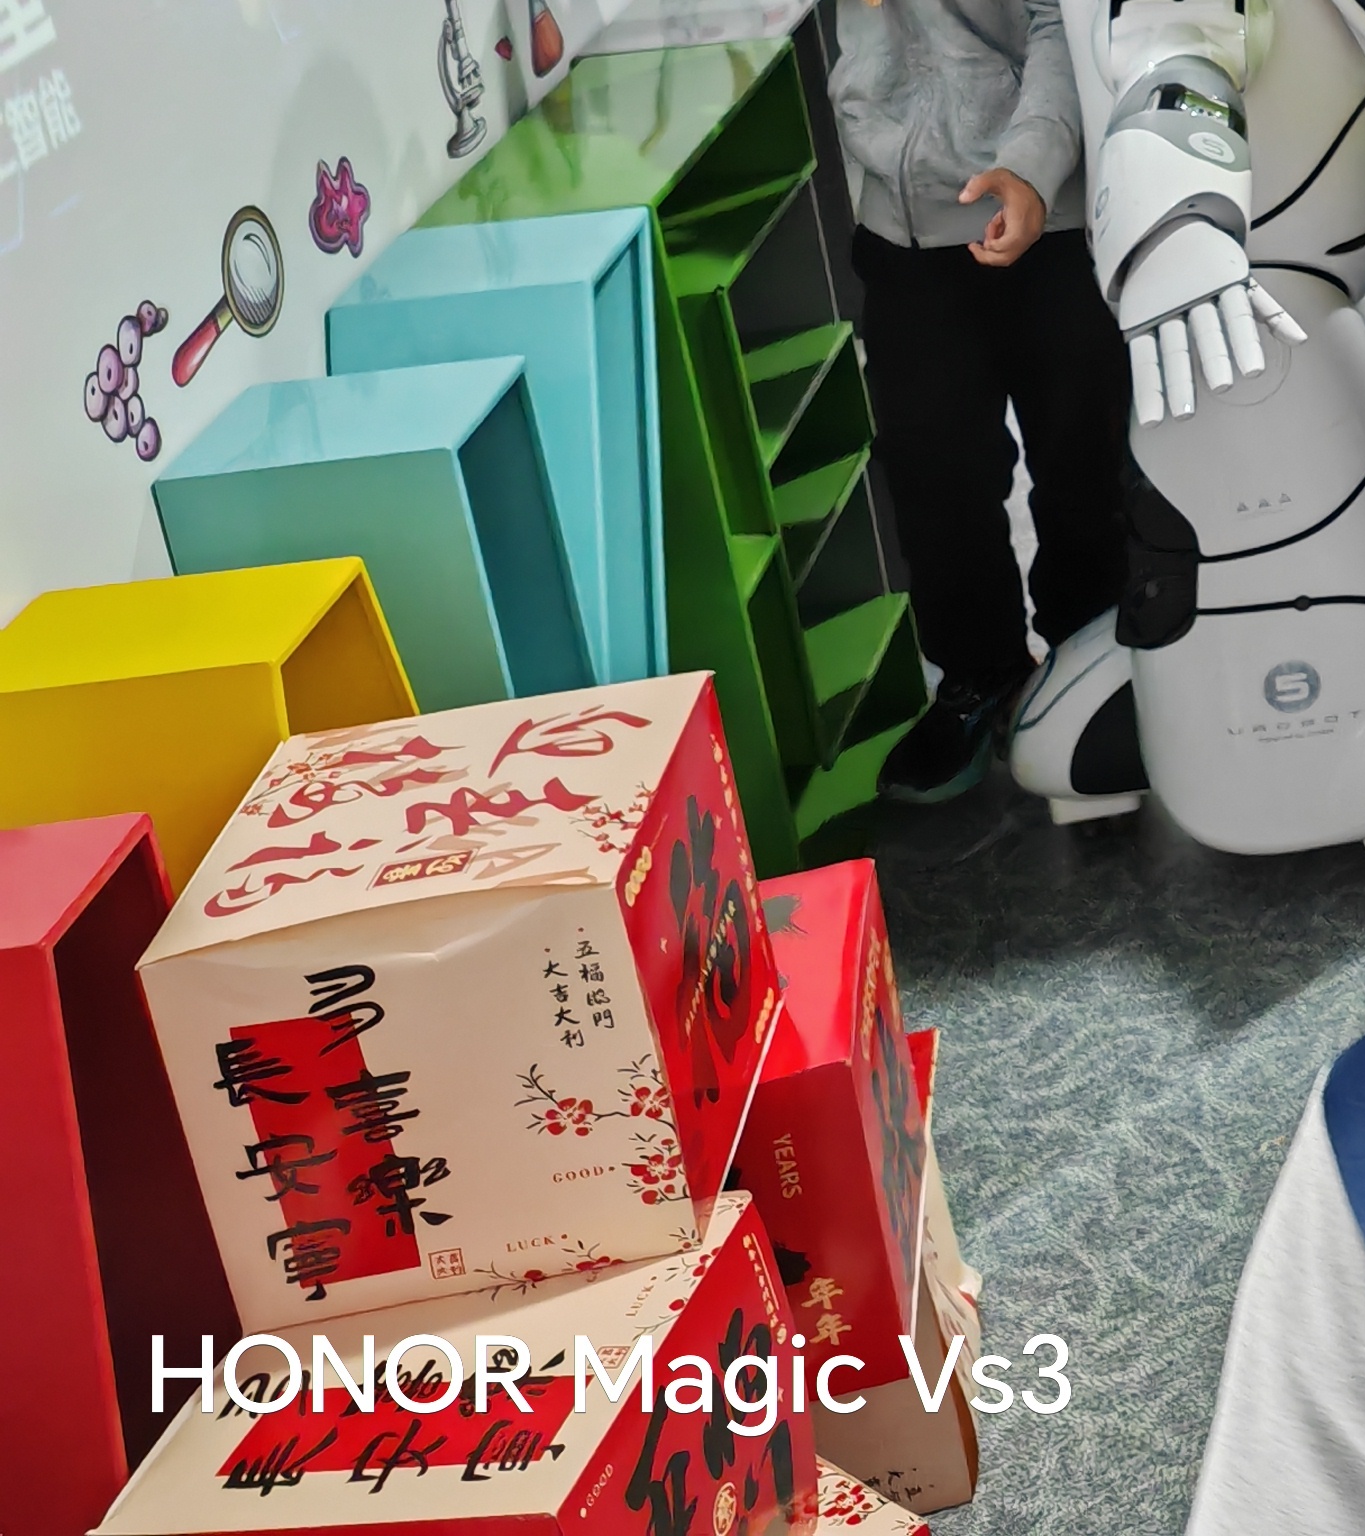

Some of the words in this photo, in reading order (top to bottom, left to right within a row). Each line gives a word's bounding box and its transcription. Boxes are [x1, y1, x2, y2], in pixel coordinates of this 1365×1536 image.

[542, 960, 585, 1049] 大吉大利
[552, 1166, 604, 1184] GOOD
[773, 1133, 803, 1200] YEARS
[506, 1235, 556, 1253] LUCK
[625, 1285, 654, 1317] LUCK
[801, 1277, 852, 1346] 年年
